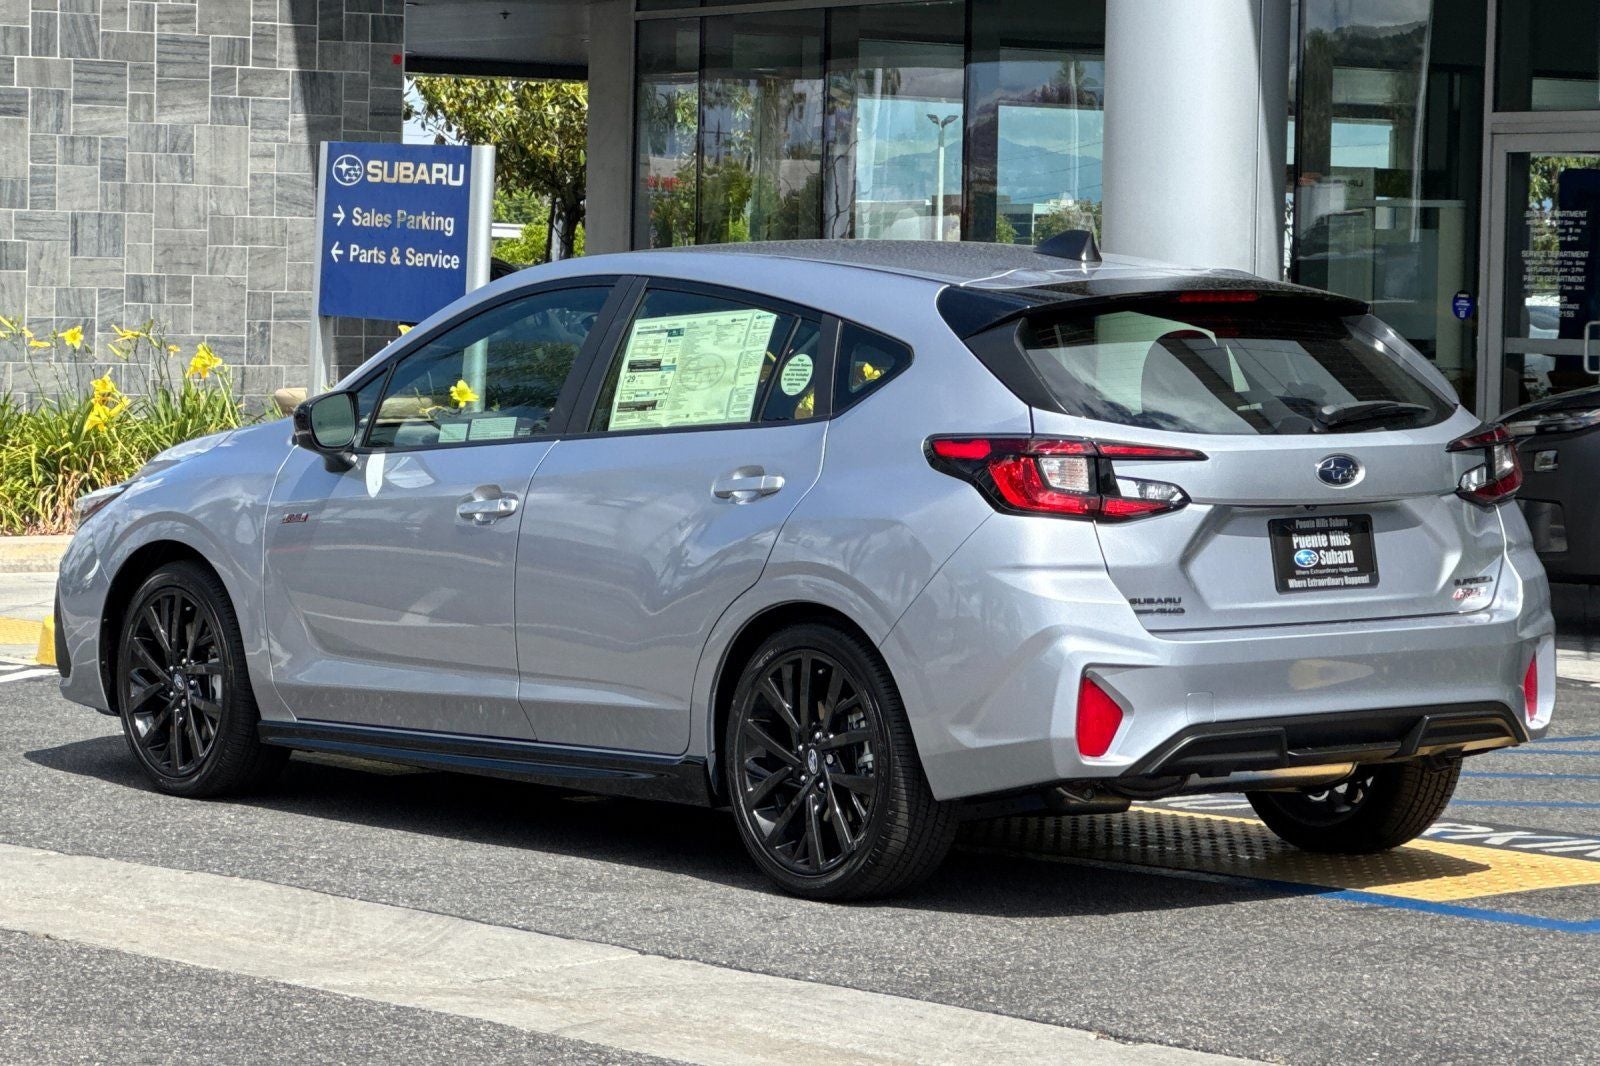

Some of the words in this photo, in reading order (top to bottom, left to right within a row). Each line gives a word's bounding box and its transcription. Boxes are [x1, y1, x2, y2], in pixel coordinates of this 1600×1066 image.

[367, 160, 465, 187] SUBARU
[352, 207, 392, 228] Sales
[396, 209, 455, 236] Parking
[350, 244, 386, 264] Parts
[390, 247, 400, 265] &
[405, 248, 460, 269] Service
[1292, 533, 1328, 549] Puente
[1329, 531, 1351, 547] Hills
[1320, 549, 1355, 565] Subaru
[1288, 578, 1308, 588] Where
[1308, 576, 1345, 587] Extraordinary
[1128, 596, 1182, 604] SUBARU
